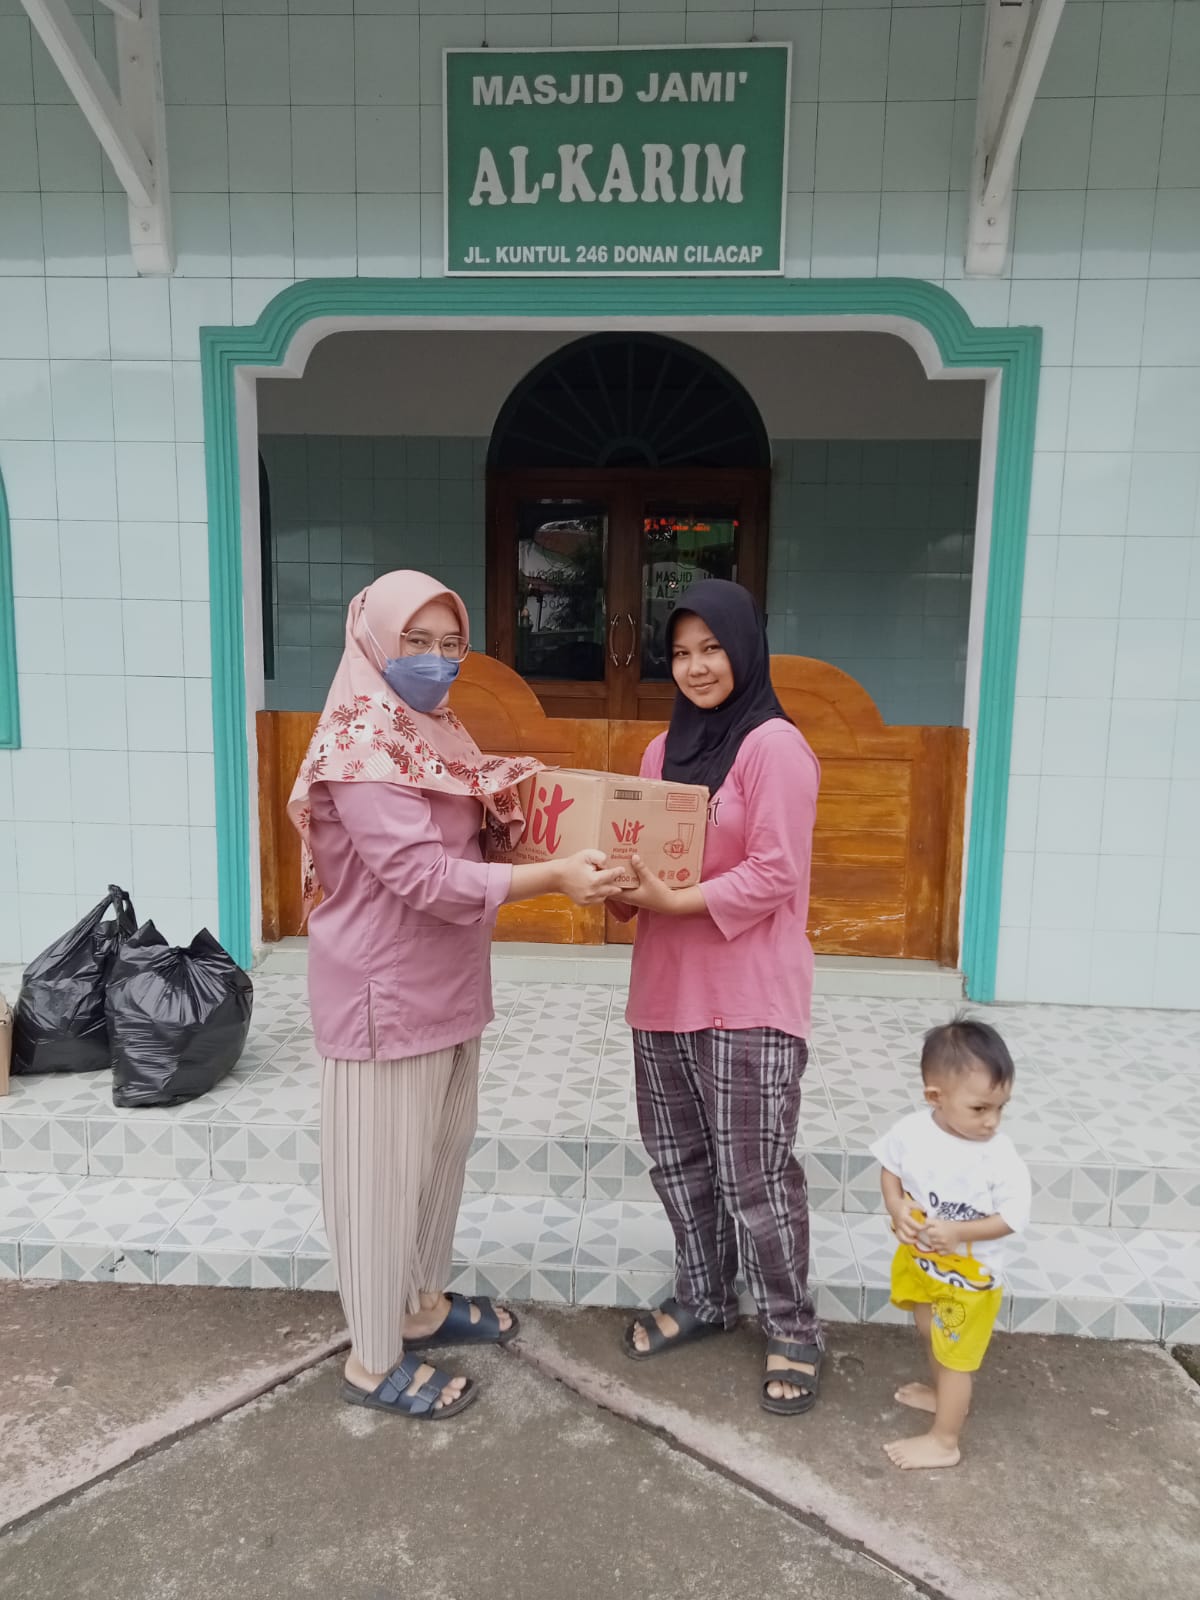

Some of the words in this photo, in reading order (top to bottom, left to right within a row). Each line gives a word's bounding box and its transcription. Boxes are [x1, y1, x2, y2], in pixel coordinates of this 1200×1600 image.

[472, 74, 624, 105] MASJID
[637, 72, 748, 102] JAMI'
[468, 143, 746, 206] AL-KARIM
[464, 246, 490, 264] JL.
[496, 246, 570, 263] KUNTUL
[576, 245, 608, 263] 246
[614, 245, 678, 263] DONAN
[684, 245, 763, 263] CILACAP
[656, 571, 693, 583] MASJID
[611, 818, 645, 845] Vit
